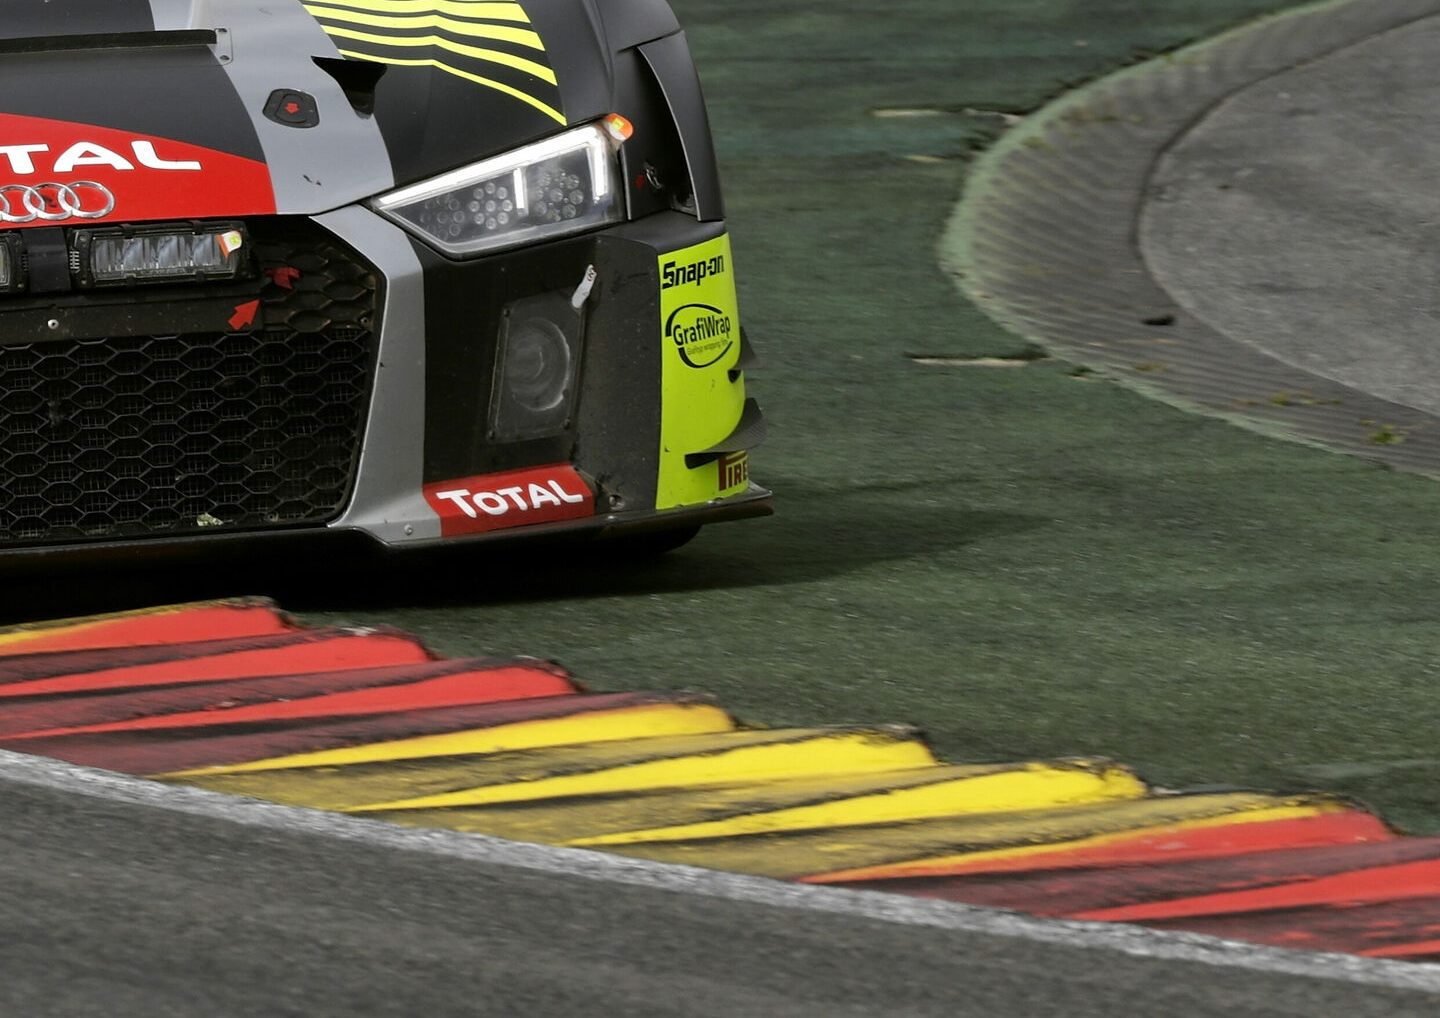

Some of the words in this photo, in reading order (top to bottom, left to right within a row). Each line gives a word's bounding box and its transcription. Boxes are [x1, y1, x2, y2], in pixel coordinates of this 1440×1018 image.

[662, 255, 724, 289] Snap-on
[673, 315, 731, 346] GrafiWrap
[436, 480, 584, 519] TOTAL
